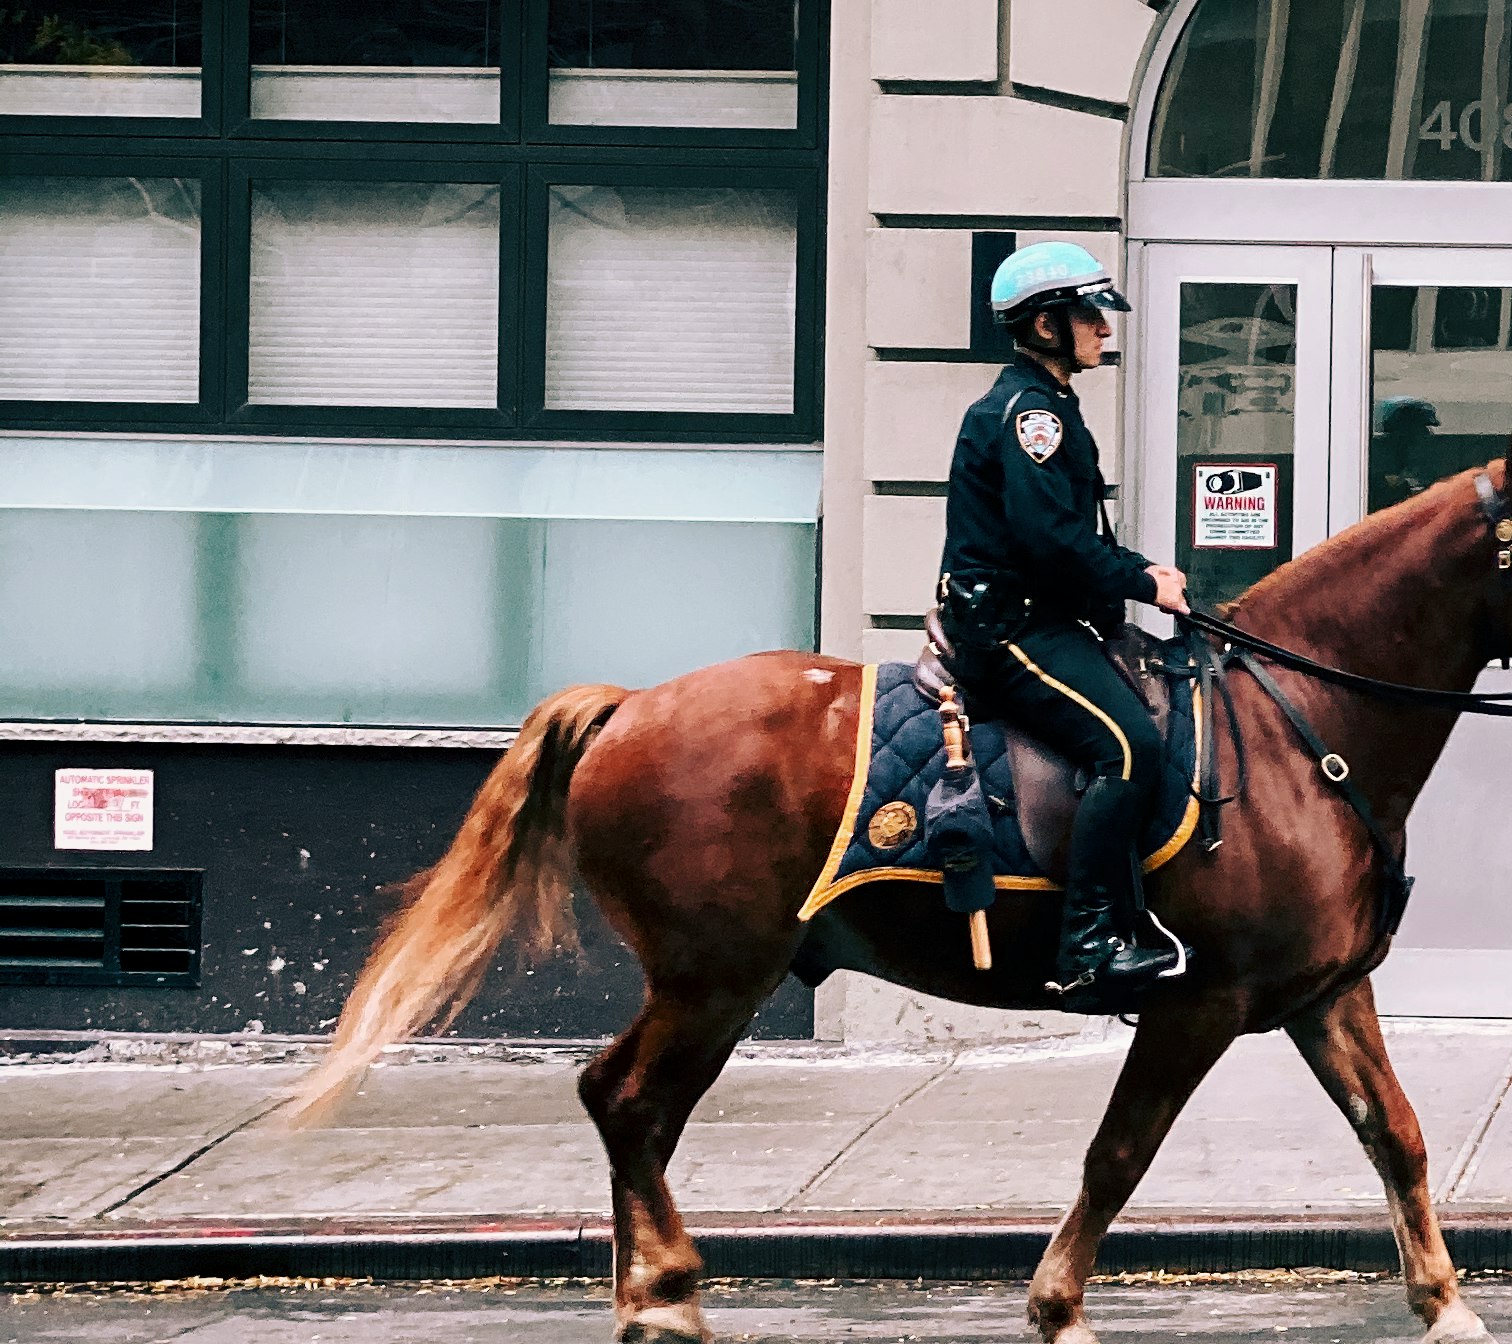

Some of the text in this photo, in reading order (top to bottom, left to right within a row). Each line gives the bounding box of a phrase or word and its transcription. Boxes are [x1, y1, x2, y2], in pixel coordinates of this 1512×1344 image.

[1204, 496, 1265, 510] WARNING
[60, 775, 150, 785] AUTOMATIC SPRINKLER
[65, 813, 102, 822] OPPOSITE
[106, 813, 123, 822] THIS
